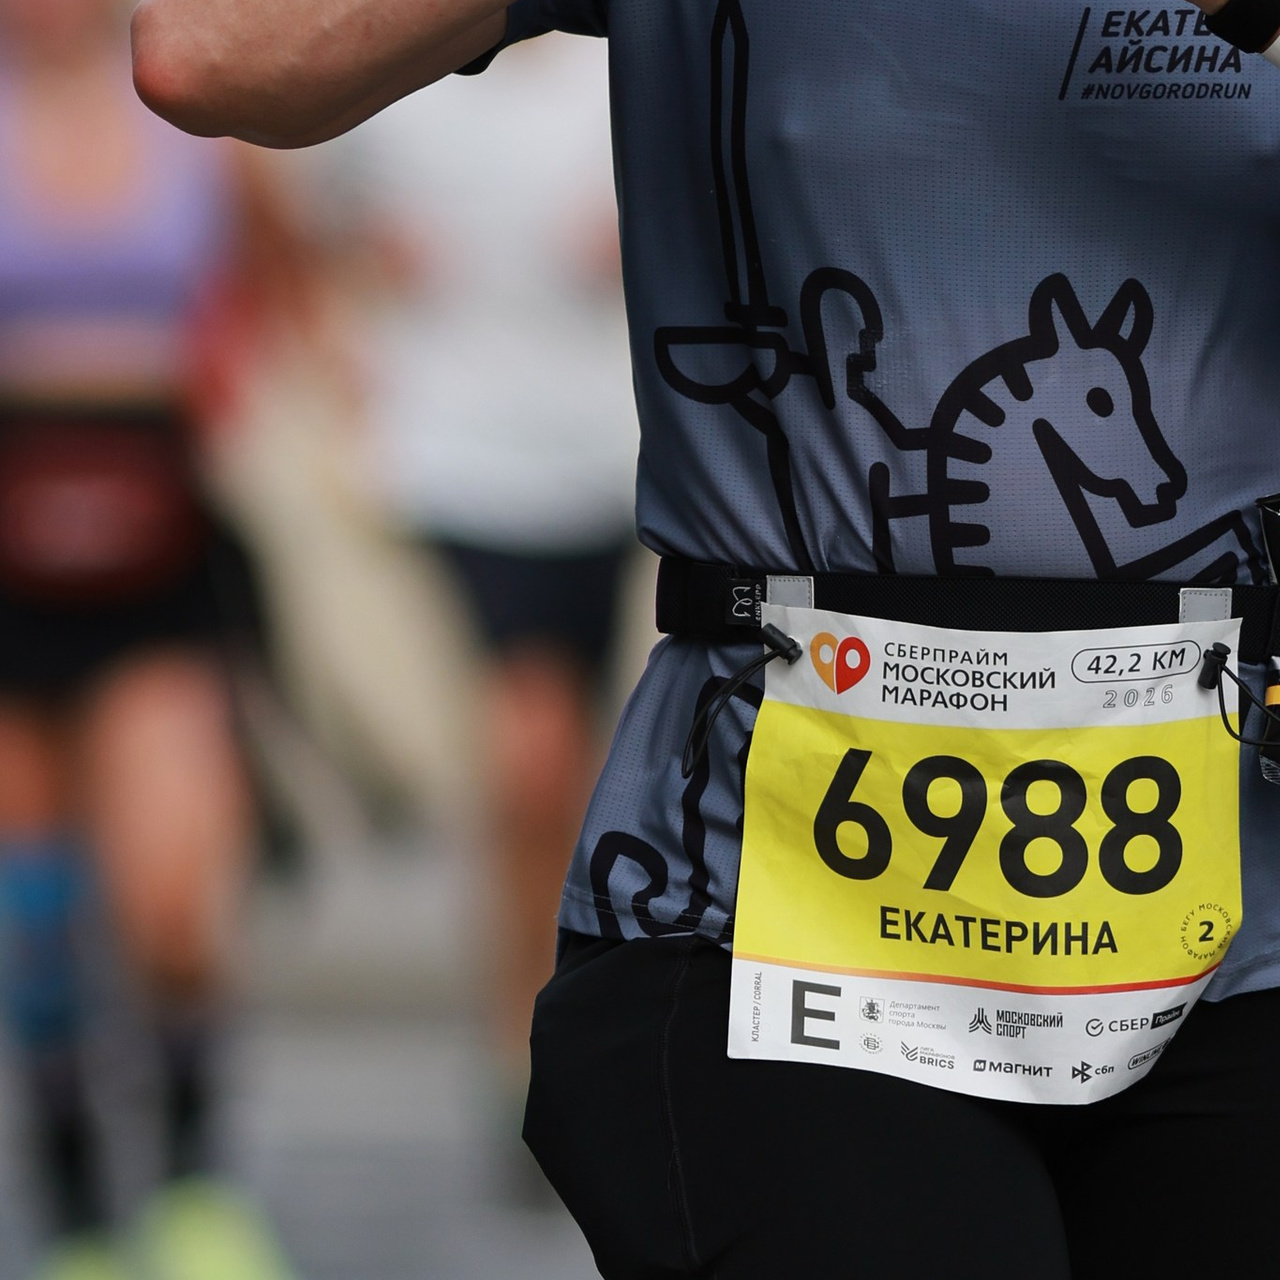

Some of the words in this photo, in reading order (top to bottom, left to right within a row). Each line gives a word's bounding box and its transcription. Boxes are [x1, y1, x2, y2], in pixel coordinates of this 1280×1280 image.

[1101, 9, 1213, 37] ЕКАТЕ
[1088, 39, 1242, 74] АЙСИНА
[1081, 82, 1252, 100] #NOVGORODRUN
[884, 642, 1008, 666] СБЕРПРАЙМ
[1087, 653, 1142, 677] 42,2
[1152, 648, 1187, 670] КМ
[883, 662, 1056, 689] МОСКОВСКИЙ
[882, 685, 1008, 712] МАРАФОН
[1103, 684, 1174, 708] 2026
[813, 747, 1183, 899] 6988
[880, 905, 1119, 955] ЕКАТЕРИНА
[1199, 920, 1214, 943] 2
[753, 971, 762, 1000] CORRAL
[791, 979, 842, 1051] E
[888, 1010, 915, 1021] спорта
[889, 1001, 940, 1013] Департамент
[996, 1009, 1064, 1028] МОСКОВСКИЙ
[751, 1006, 761, 1042] КЛАСТЕР
[888, 1018, 915, 1028] города
[916, 1021, 947, 1031] Москвы
[996, 1023, 1027, 1039] СПОРТ
[1108, 1017, 1149, 1032] СБЕР
[919, 1055, 955, 1070] BRICS
